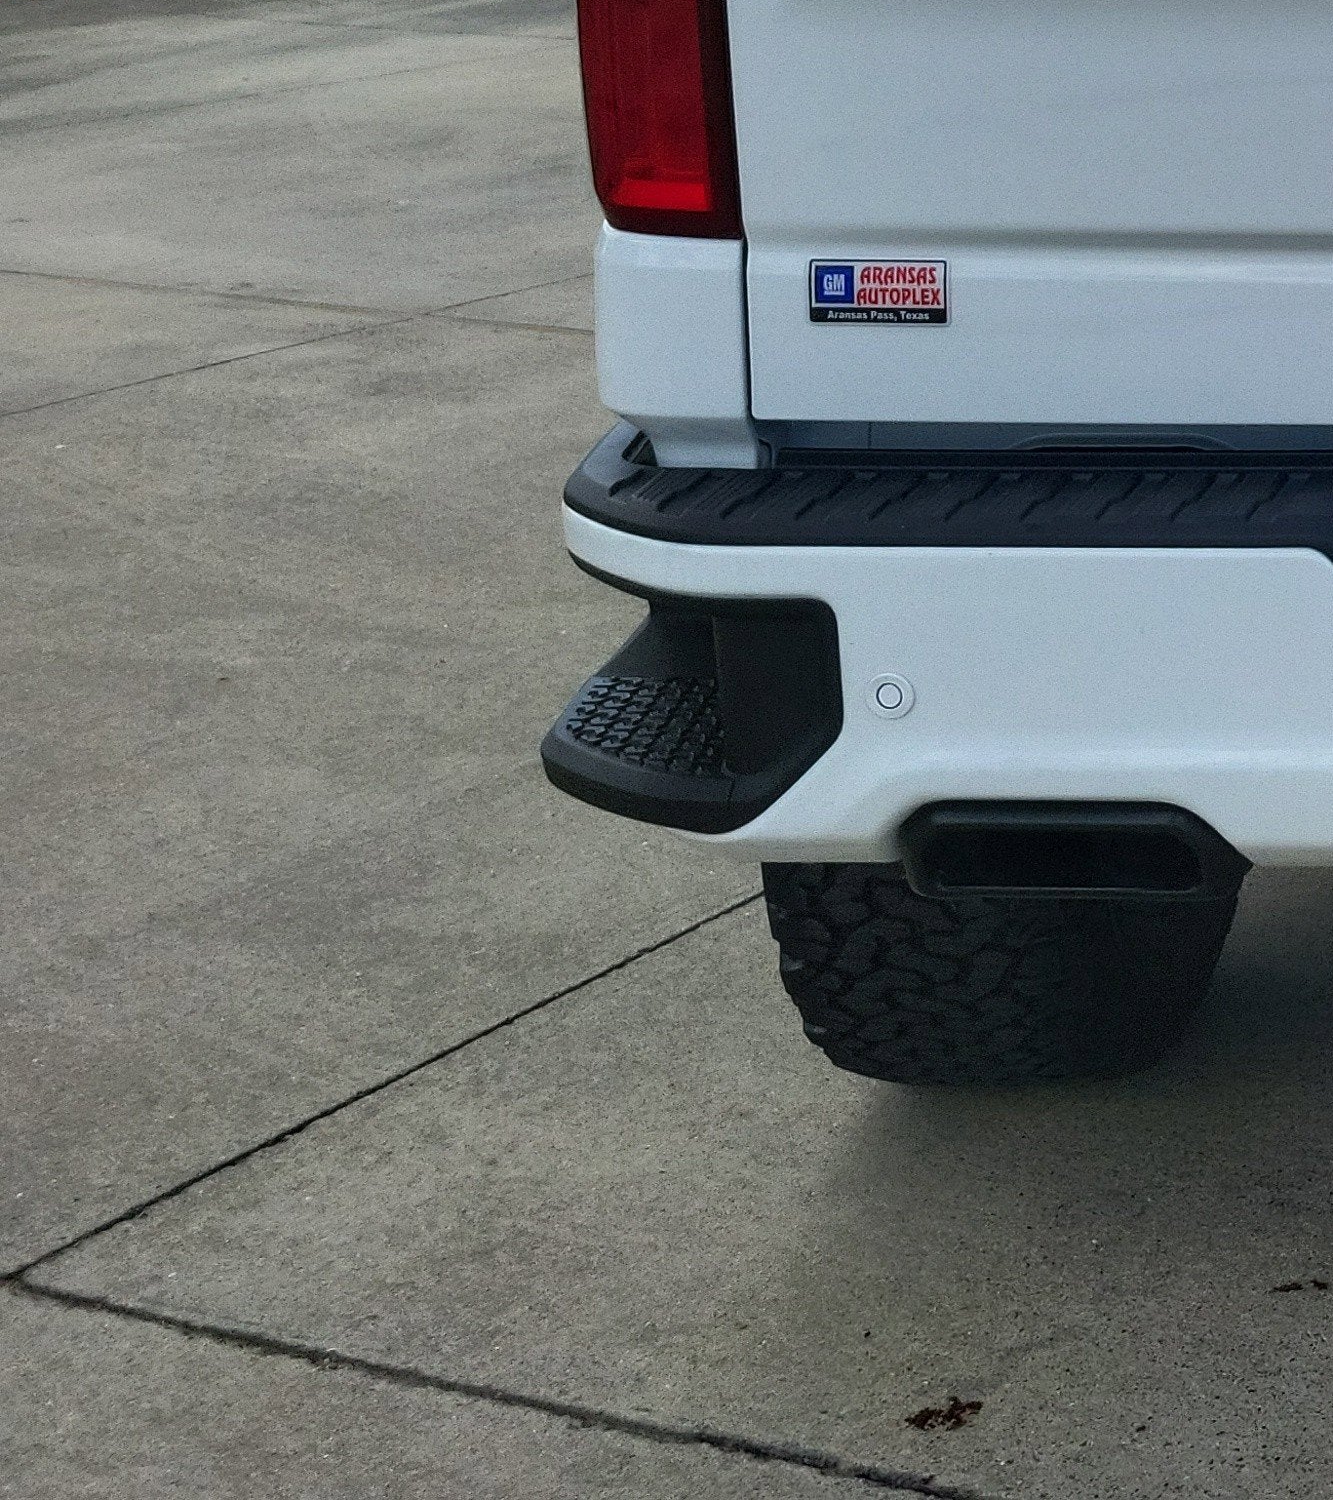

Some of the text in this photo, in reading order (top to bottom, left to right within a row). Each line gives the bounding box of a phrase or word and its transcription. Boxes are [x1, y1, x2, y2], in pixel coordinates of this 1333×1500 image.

[823, 273, 846, 292] GM
[860, 266, 937, 286] ARANSAS
[857, 287, 942, 306] AUTOPLEX
[827, 310, 930, 321] Aransas Pass, Texas
